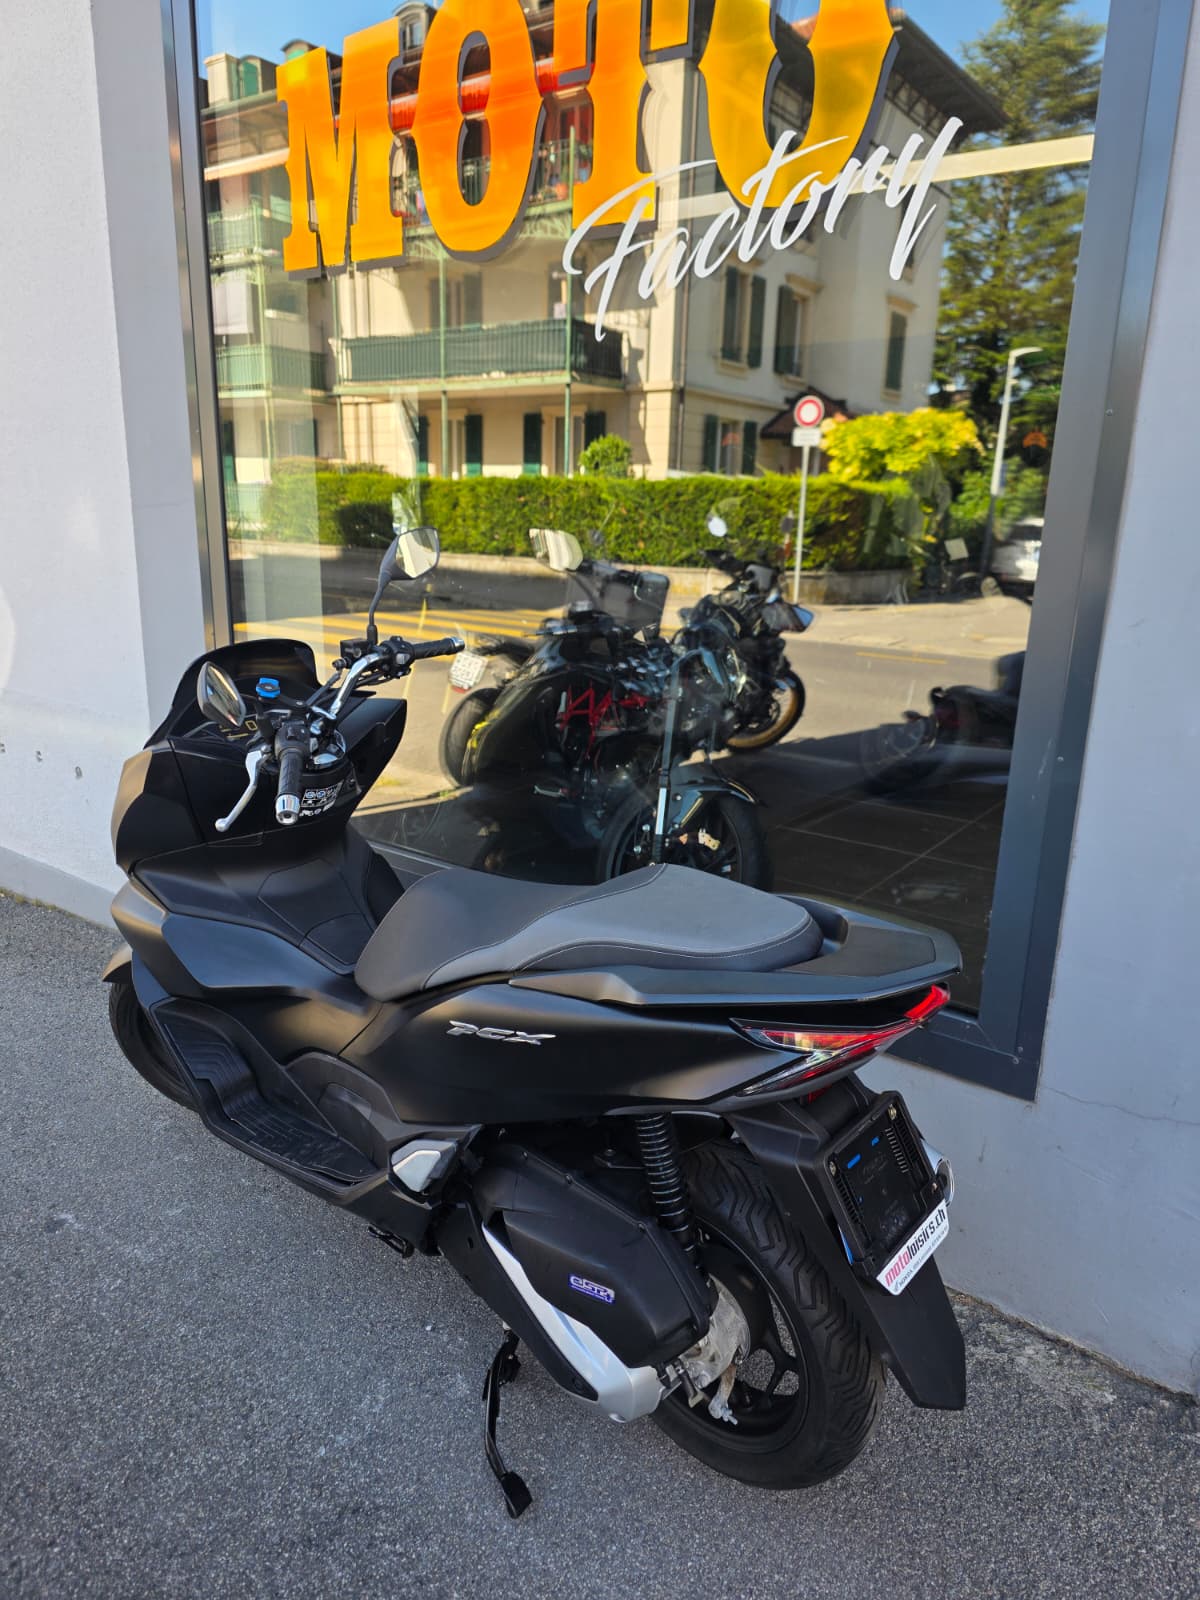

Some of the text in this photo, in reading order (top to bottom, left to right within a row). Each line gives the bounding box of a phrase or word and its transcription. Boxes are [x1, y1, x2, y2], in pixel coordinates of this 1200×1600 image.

[276, 0, 898, 276] MOTO
[562, 116, 964, 341] Factory
[446, 1020, 556, 1045] PCX
[885, 1208, 946, 1287] motoloisirs.ch
